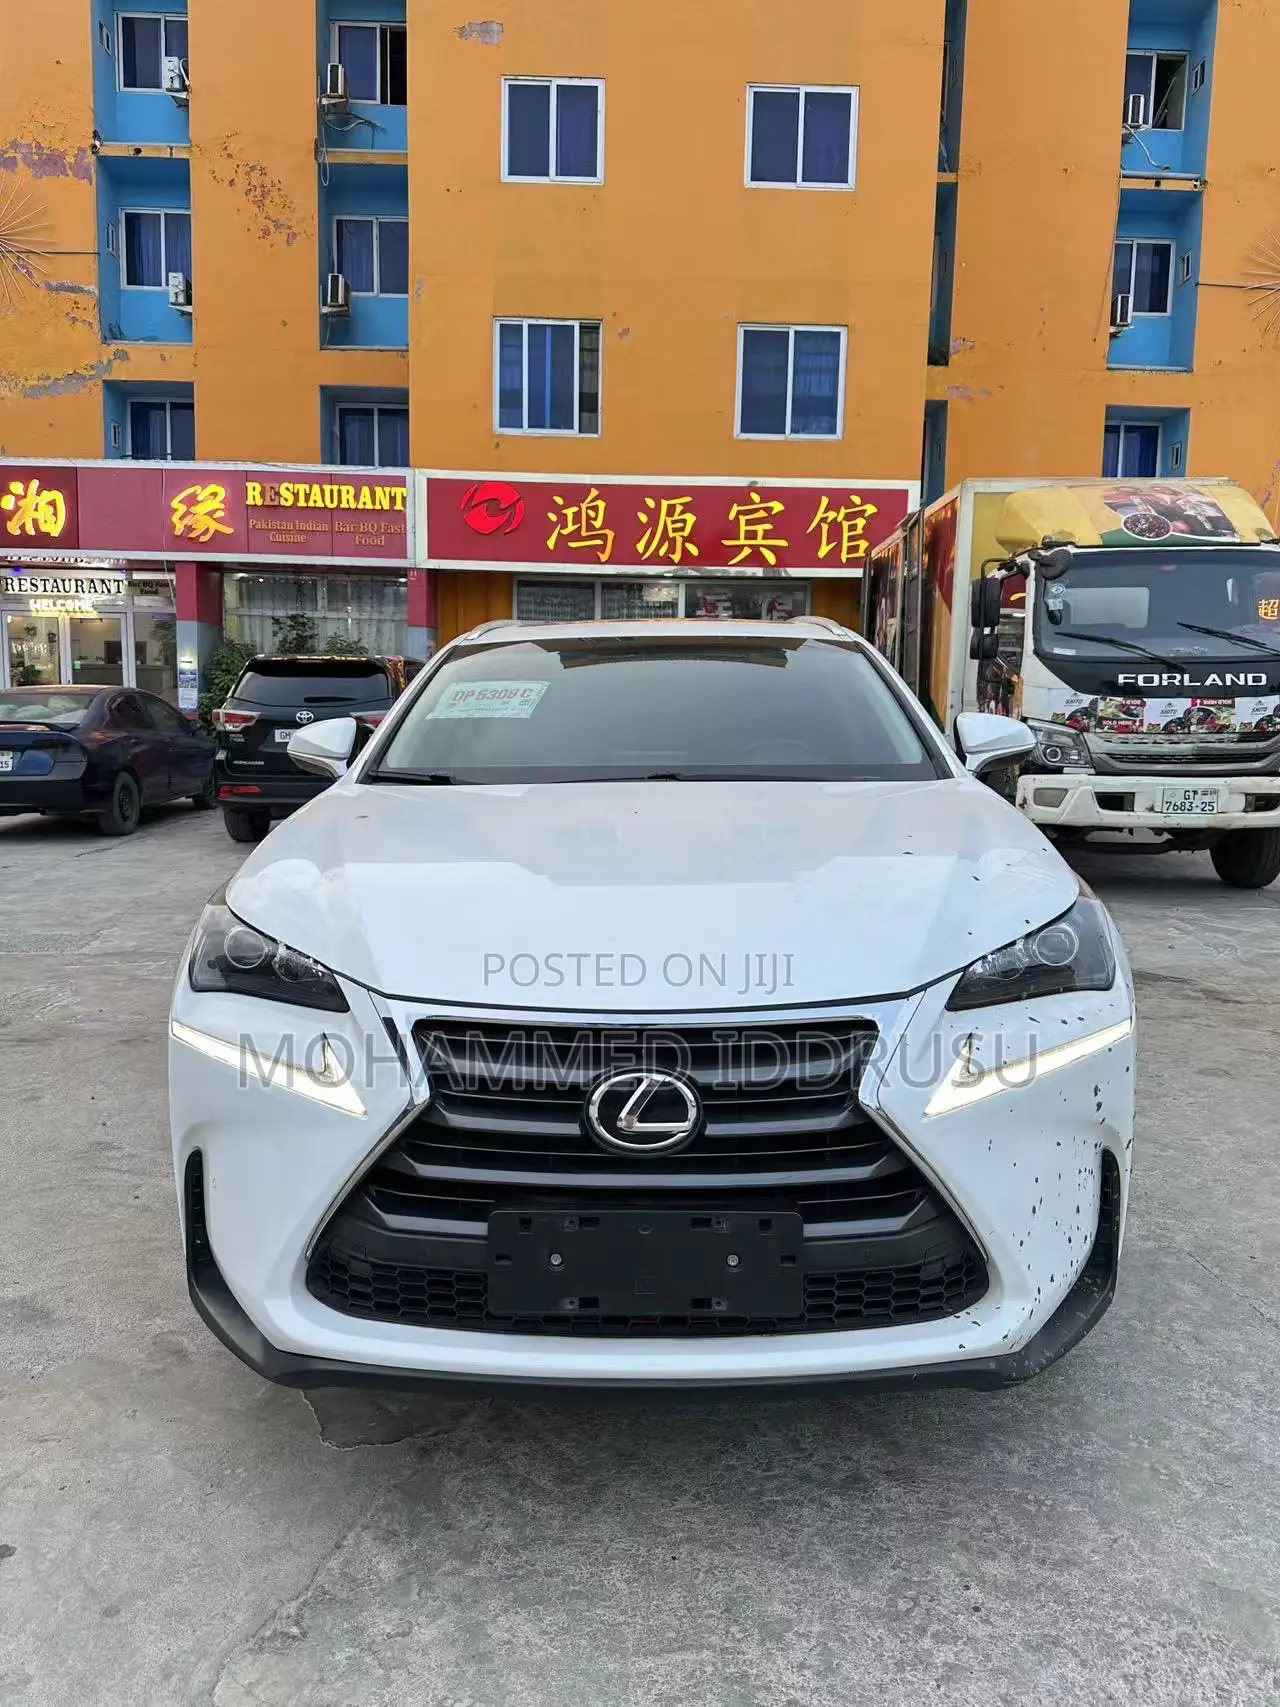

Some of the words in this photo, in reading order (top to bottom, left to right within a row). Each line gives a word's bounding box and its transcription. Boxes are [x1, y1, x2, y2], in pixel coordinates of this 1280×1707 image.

[245, 481, 408, 511] RESTAURANT
[0, 479, 66, 537] 湘
[170, 483, 235, 542] 缘
[249, 519, 293, 531] Pakistan
[295, 520, 329, 532] Indian
[335, 521, 356, 533] Bar
[360, 522, 377, 534] BQ
[546, 487, 880, 566] 鸿源宾馆
[269, 531, 307, 543] Cuisine
[355, 535, 385, 546] Food
[4, 577, 124, 594] RESTAURANT
[29, 599, 96, 611] WELCOME
[1257, 598, 1280, 620] 超
[1118, 673, 1268, 687] FORLAND
[451, 689, 476, 702] DP
[520, 688, 533, 699] C
[1183, 789, 1199, 801] GT
[1164, 801, 1215, 812] 7683-25
